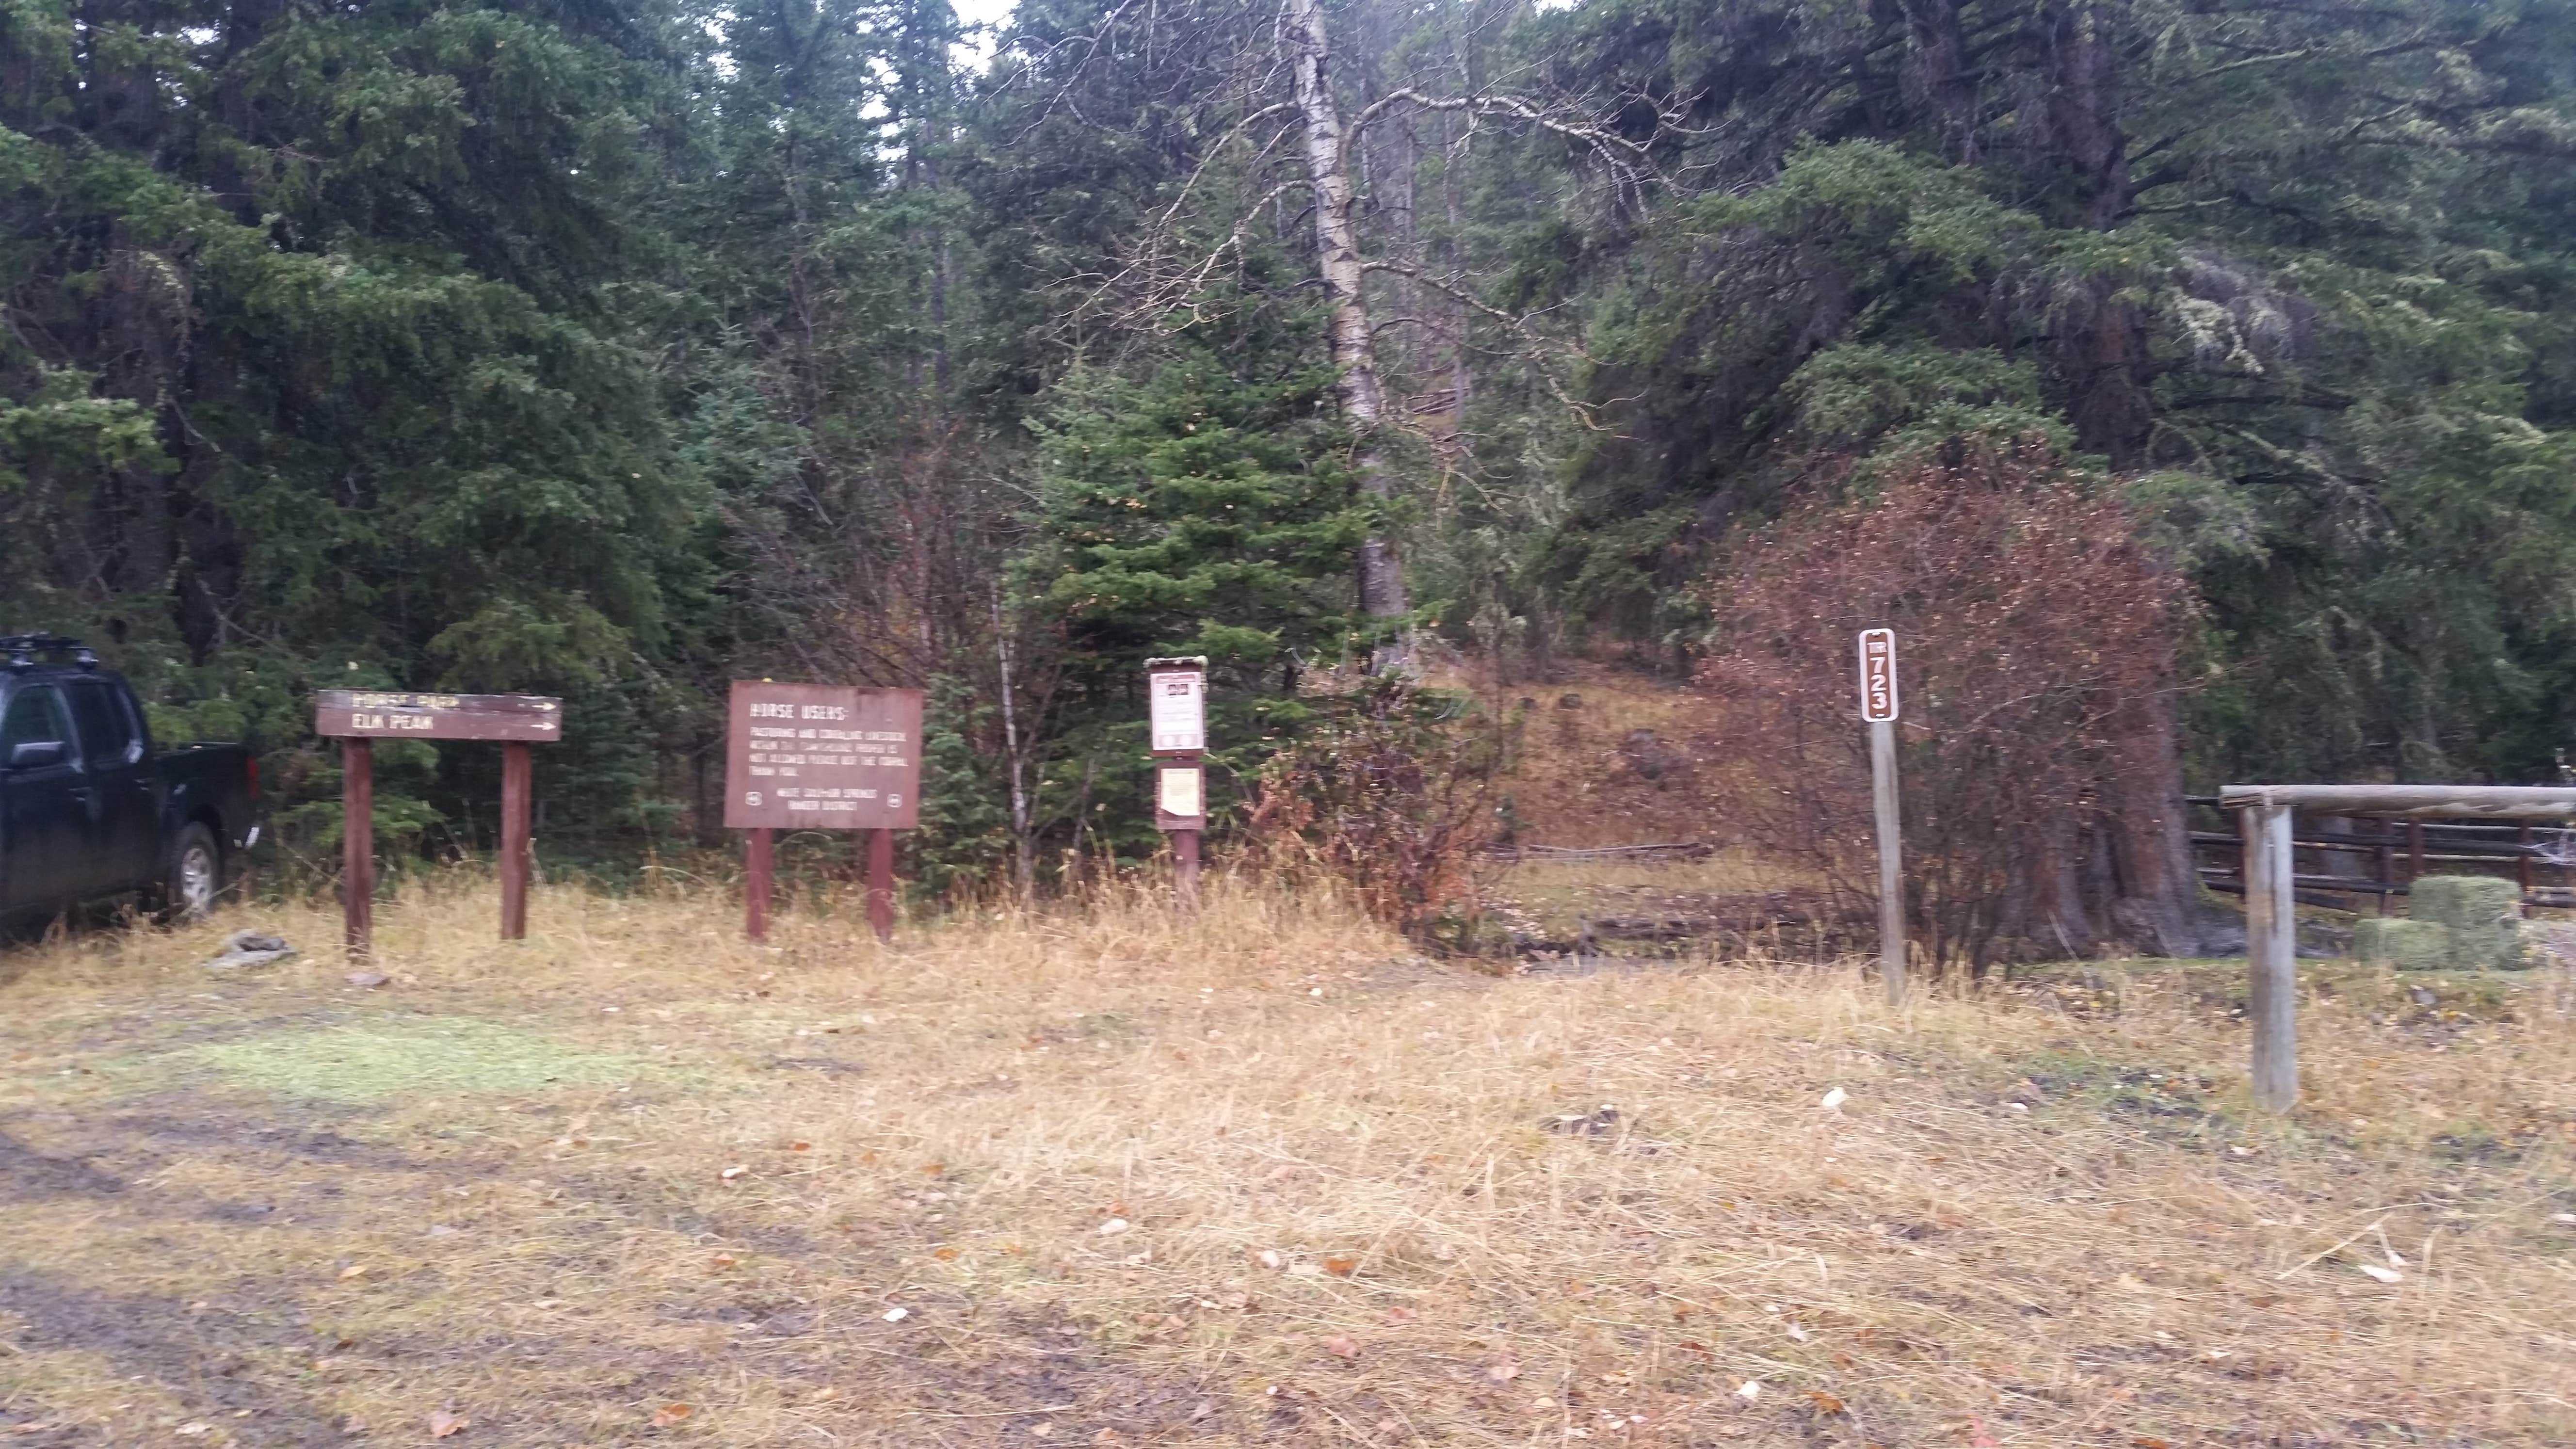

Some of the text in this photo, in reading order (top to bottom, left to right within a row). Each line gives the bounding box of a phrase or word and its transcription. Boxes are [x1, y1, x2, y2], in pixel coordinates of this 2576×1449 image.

[750, 703, 794, 718] HORSE
[352, 713, 434, 729] ELK PEAK
